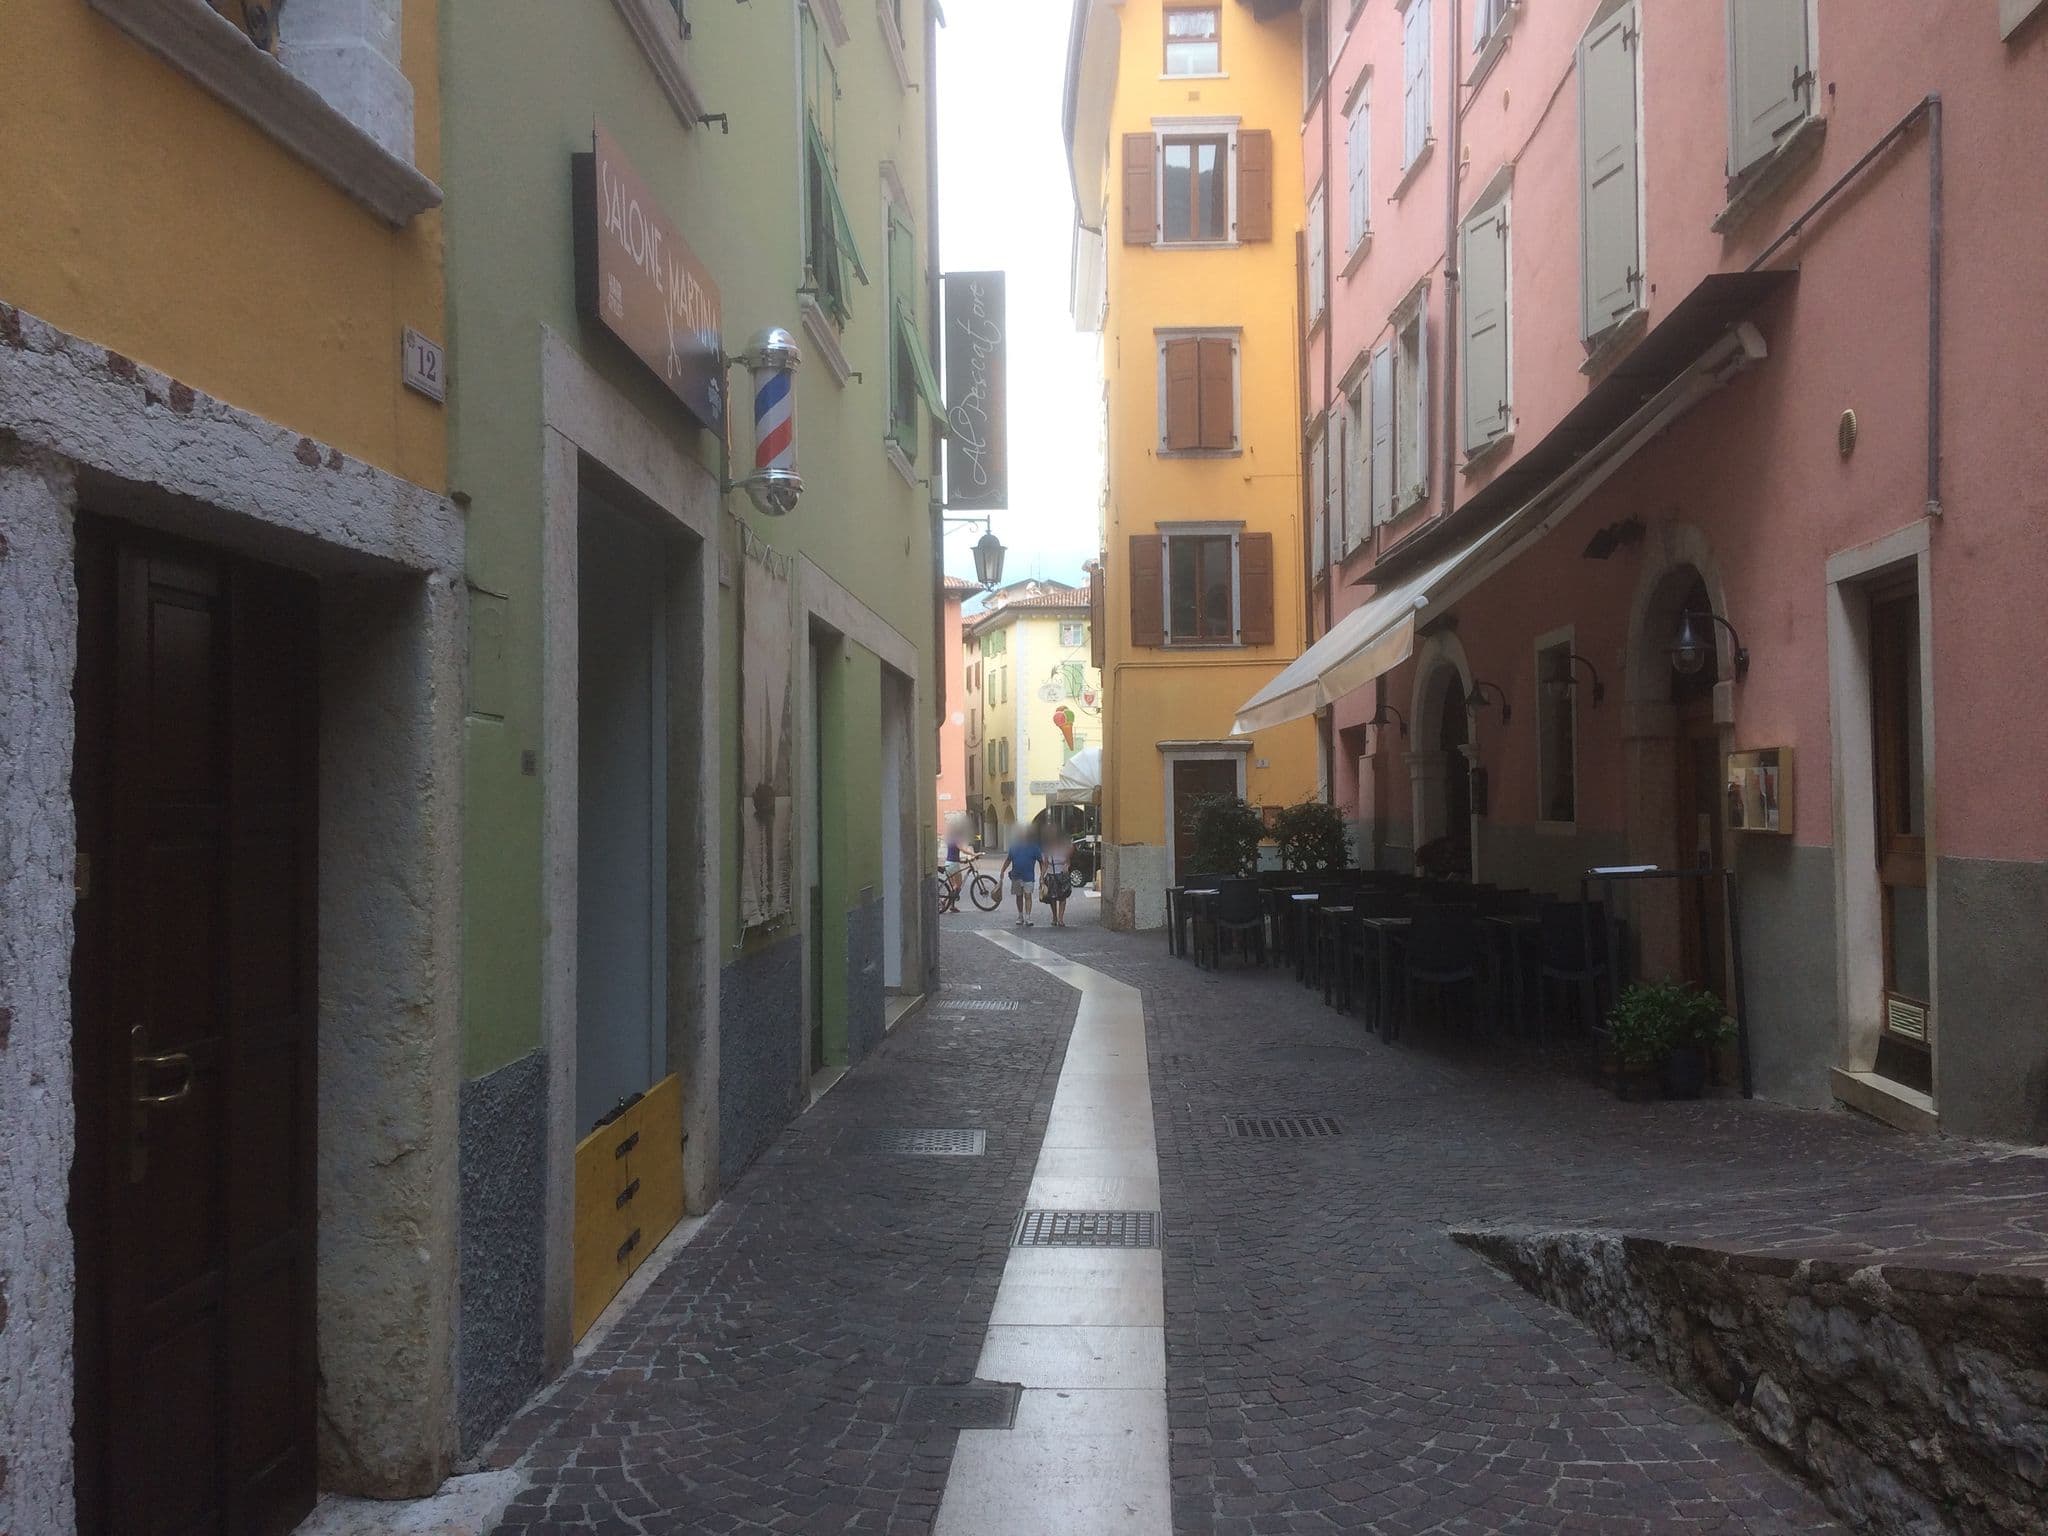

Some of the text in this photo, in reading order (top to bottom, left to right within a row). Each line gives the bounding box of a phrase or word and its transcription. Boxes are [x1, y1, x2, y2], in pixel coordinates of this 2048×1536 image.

[602, 161, 720, 363] SALONE MARTINA
[418, 345, 437, 382] 12
